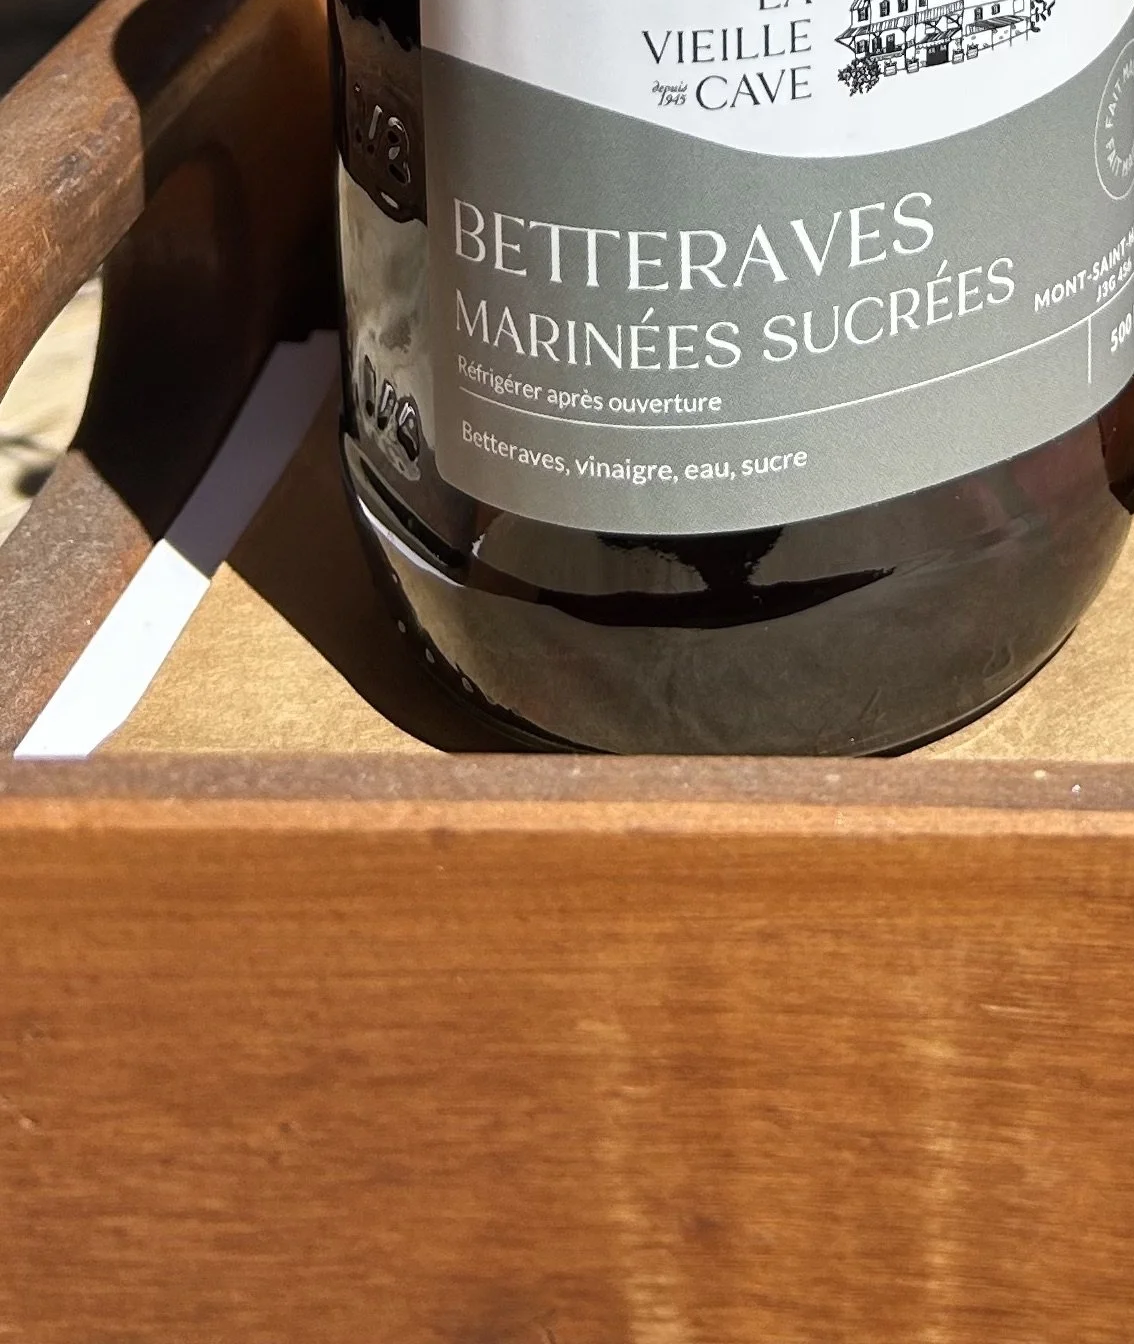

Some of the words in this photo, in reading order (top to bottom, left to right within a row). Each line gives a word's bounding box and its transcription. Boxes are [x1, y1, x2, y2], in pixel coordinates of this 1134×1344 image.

[641, 18, 813, 64] VIEILLE
[651, 80, 688, 98] depuis
[657, 92, 687, 107] 1945
[695, 65, 813, 111] CAVE
[452, 190, 936, 292] BETTERAVES
[1096, 274, 1117, 303] J3G
[455, 288, 742, 371] MARINÉES
[761, 257, 1016, 363] SUCRÉES
[1110, 312, 1132, 353] 500
[457, 354, 543, 401] Réfrigérer
[546, 388, 604, 410] après
[608, 394, 723, 413] ouverture
[461, 419, 571, 477] Betteraves,
[574, 455, 680, 486] vinaigre,
[684, 460, 736, 481] eau,
[740, 449, 809, 477] sucre
